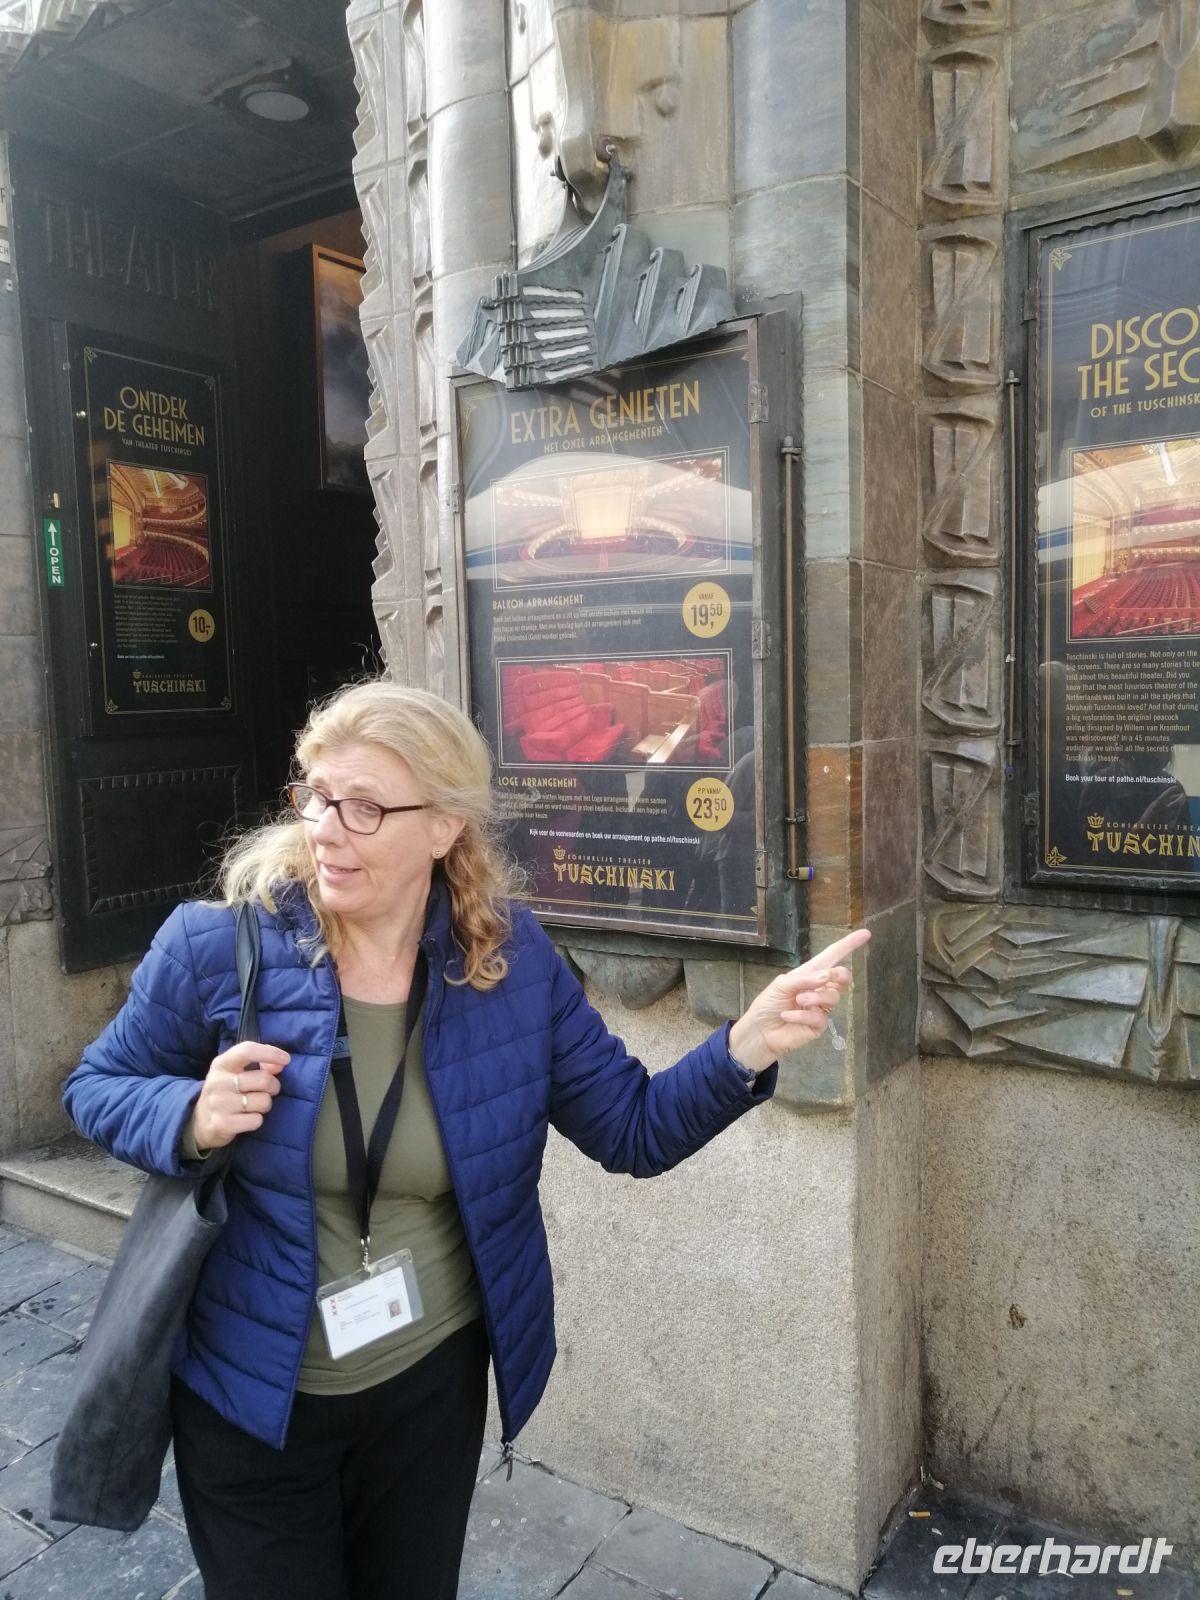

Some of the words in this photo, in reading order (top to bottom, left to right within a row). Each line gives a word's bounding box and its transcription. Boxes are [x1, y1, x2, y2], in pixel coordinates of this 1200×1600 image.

[1091, 305, 1200, 360] DISCO
[1078, 359, 1129, 401] THE
[120, 386, 188, 420] ONTDEK
[1091, 407, 1108, 418] OF
[1114, 402, 1132, 415] THE
[510, 403, 580, 444] EXTRA
[589, 380, 700, 431] GENIETEN
[104, 407, 126, 433] DE
[133, 414, 205, 446] GEHEIMEN
[562, 438, 585, 451] ONZE
[589, 426, 663, 448] ARRANGEMENTEN
[122, 438, 133, 446] VAN
[135, 440, 158, 451] THEATER
[161, 445, 192, 456] TUSCHINSKI
[49, 547, 62, 585] OPEN
[493, 599, 524, 610] BALKON
[527, 594, 583, 608] ARRANGEMENT
[1163, 650, 1175, 659] only
[1104, 662, 1119, 670] There
[1142, 662, 1159, 670] many
[133, 680, 207, 693] TUSCHINSKI
[1162, 693, 1181, 701] styles
[1178, 703, 1199, 712] during
[1128, 714, 1151, 722] original
[1154, 714, 1179, 722] peacock
[1116, 724, 1123, 732] by
[498, 776, 518, 786] LOGE
[522, 777, 577, 788] ARRANGEMENT
[1065, 774, 1080, 782] Book
[1116, 775, 1176, 784] pathe.nl/tuschinski
[619, 857, 651, 865] THEATER
[553, 863, 675, 891] TUSCHINSKI
